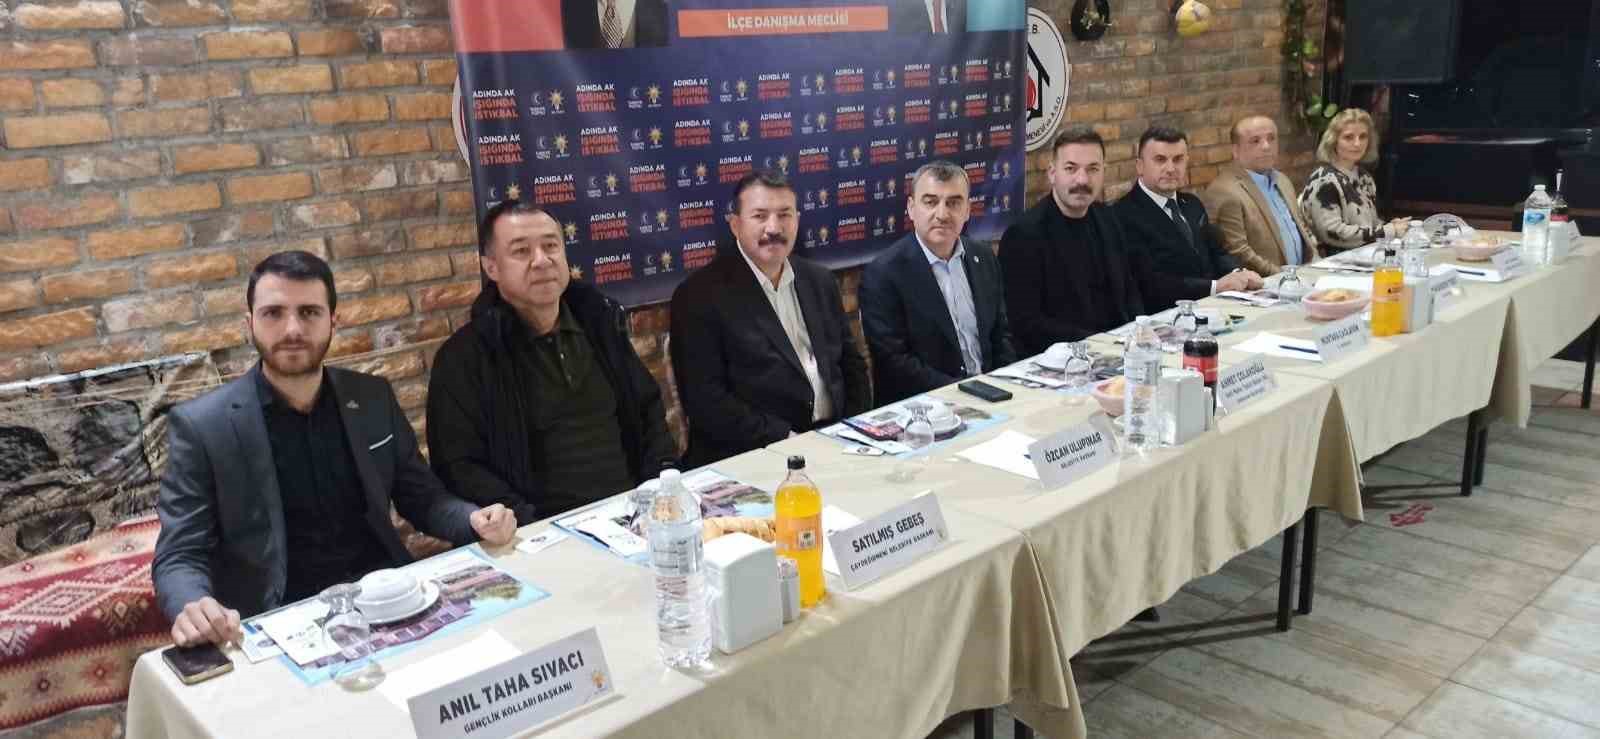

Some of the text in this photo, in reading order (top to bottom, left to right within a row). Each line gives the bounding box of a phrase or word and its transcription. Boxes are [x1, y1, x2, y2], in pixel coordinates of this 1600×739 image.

[728, 12, 752, 31] İLÇE
[754, 16, 805, 31] DANIŞMA
[479, 136, 507, 144] ADINDA
[630, 165, 654, 173] ADINDA
[535, 176, 562, 184] ADINDA
[591, 212, 614, 221] ADINDA
[594, 256, 620, 264] ADINDA
[1044, 432, 1102, 463] ÖZCAN ULUPINAR
[852, 512, 925, 553] SATILMIŞ GEBEŞ
[439, 650, 585, 724] ANIL TAHA SIVACI
[464, 681, 572, 734] GENÇLİK KOLLARI BAŞKANI
